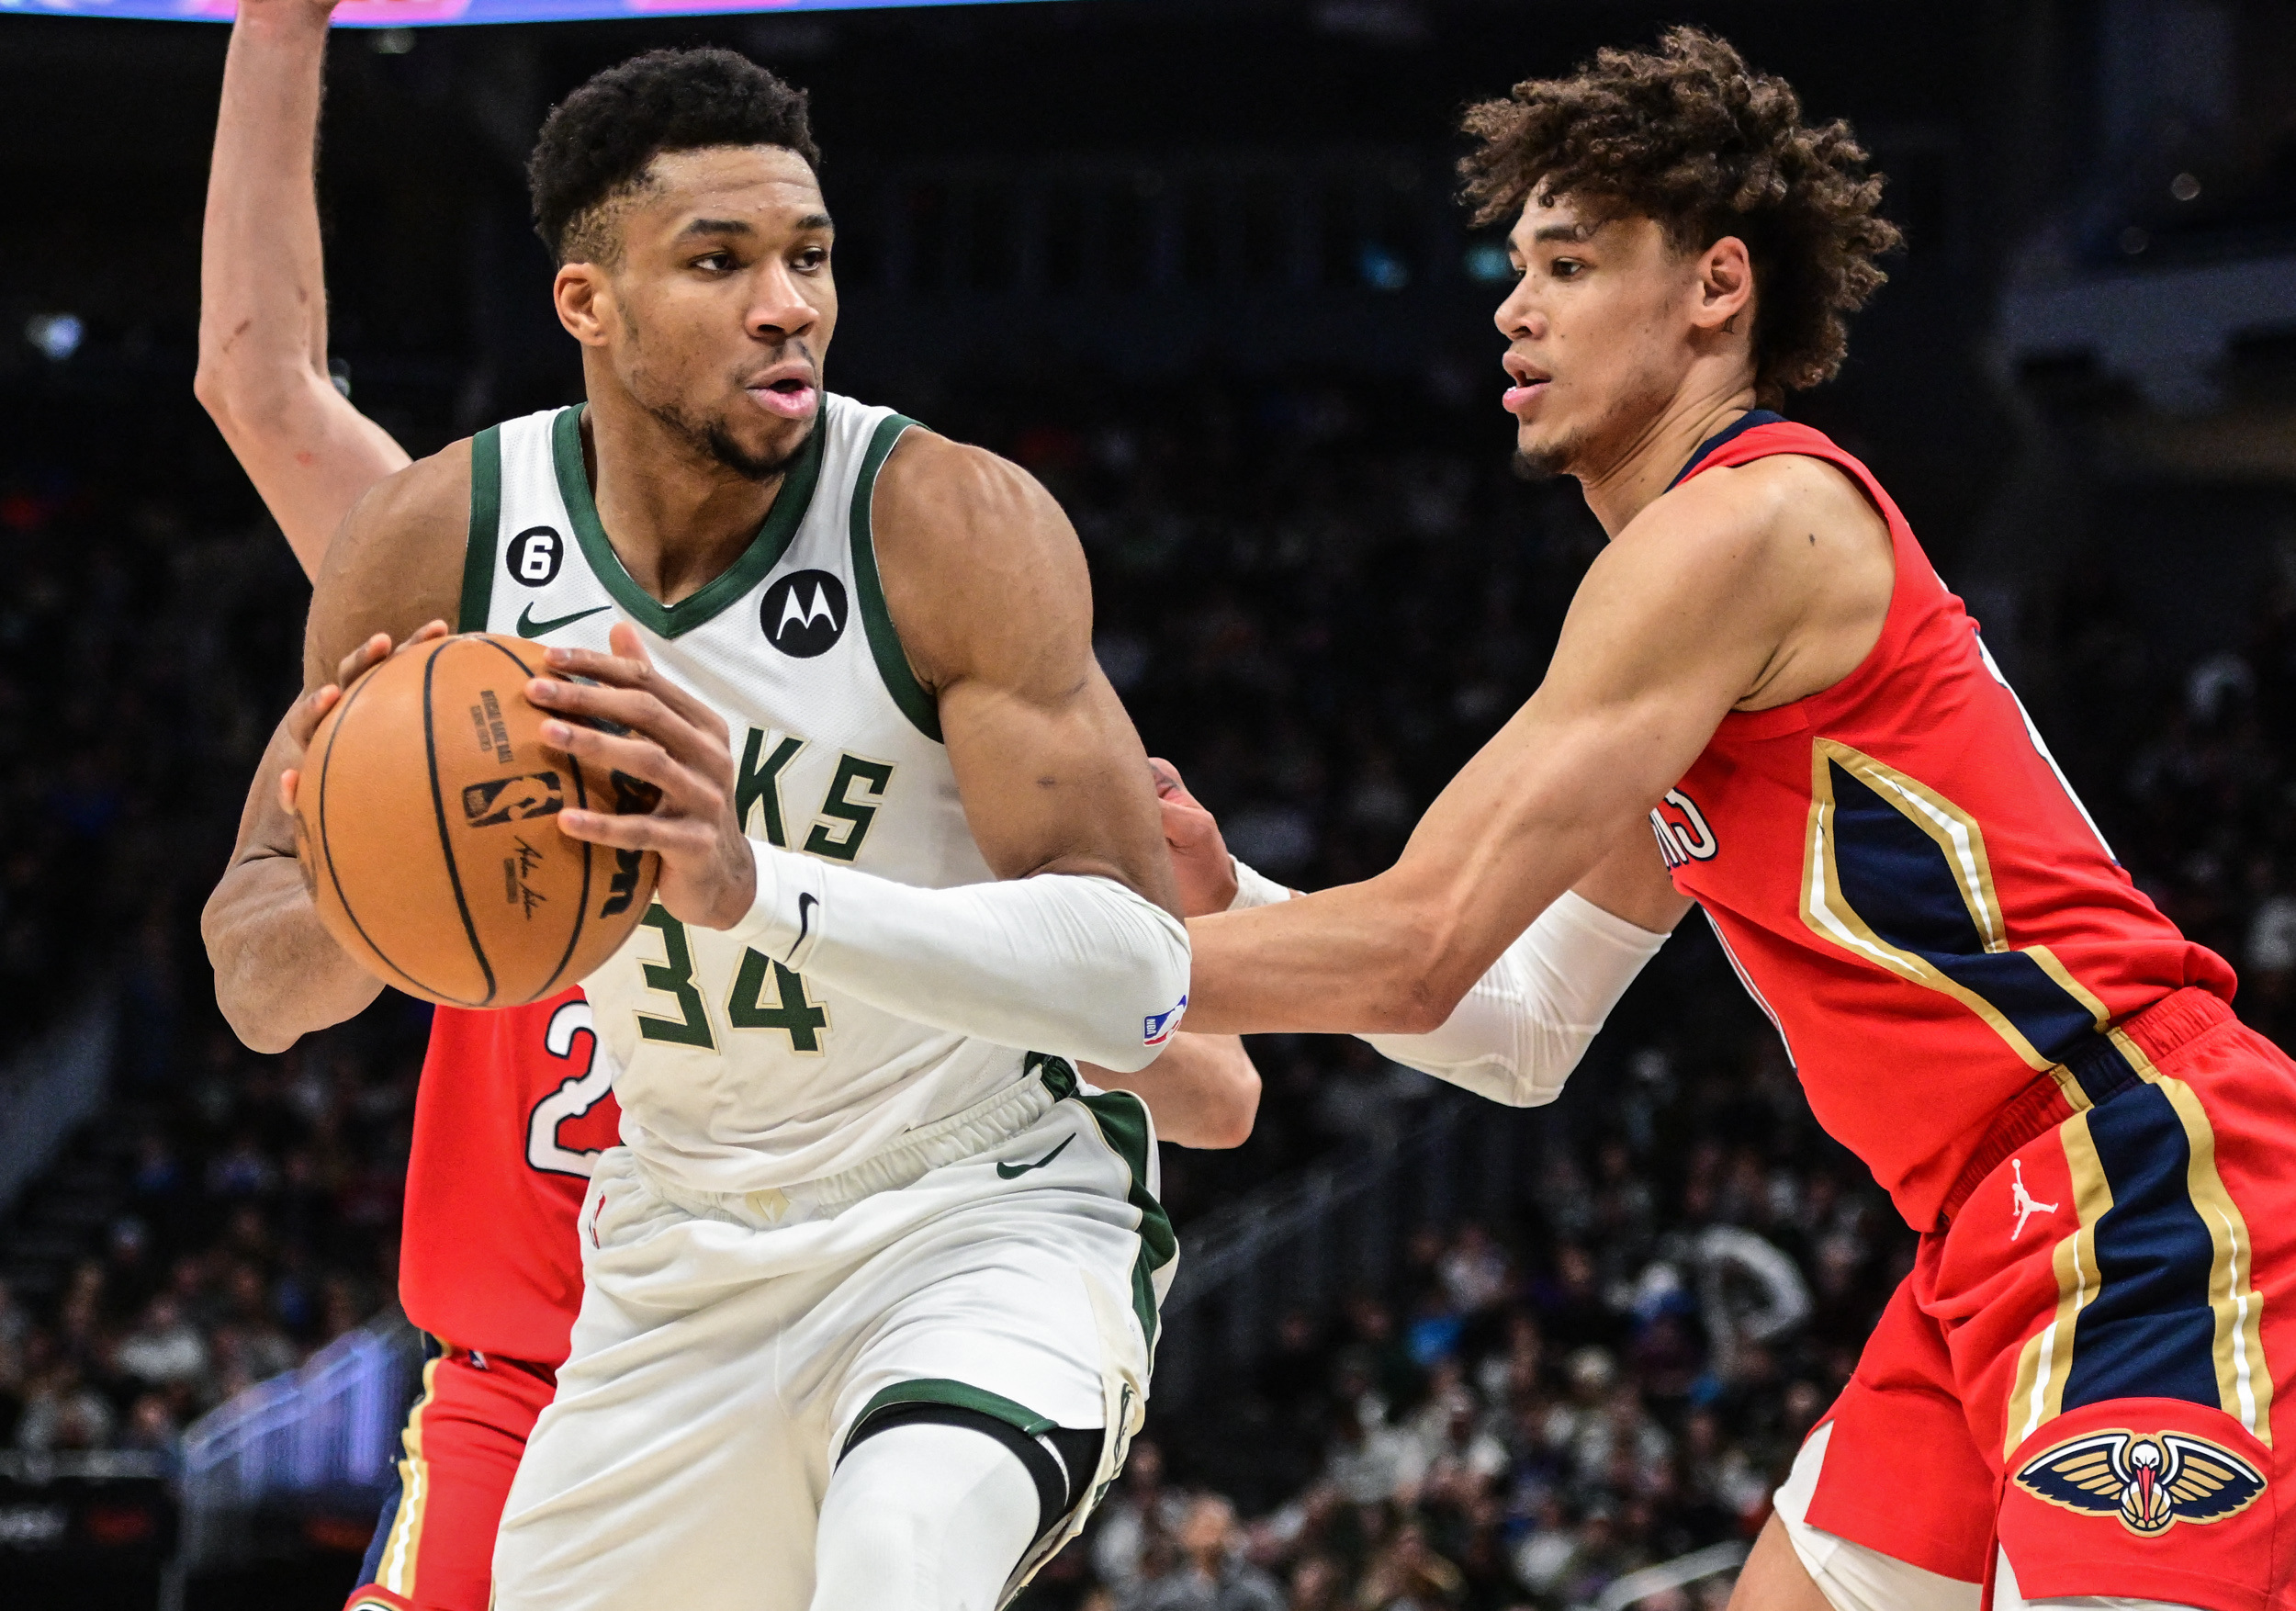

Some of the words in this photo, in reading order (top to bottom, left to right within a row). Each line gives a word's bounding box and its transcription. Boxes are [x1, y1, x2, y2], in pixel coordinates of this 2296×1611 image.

[520, 535, 554, 580] 6
[632, 889, 833, 1057] 34
[1146, 1019, 1157, 1035] NBA
